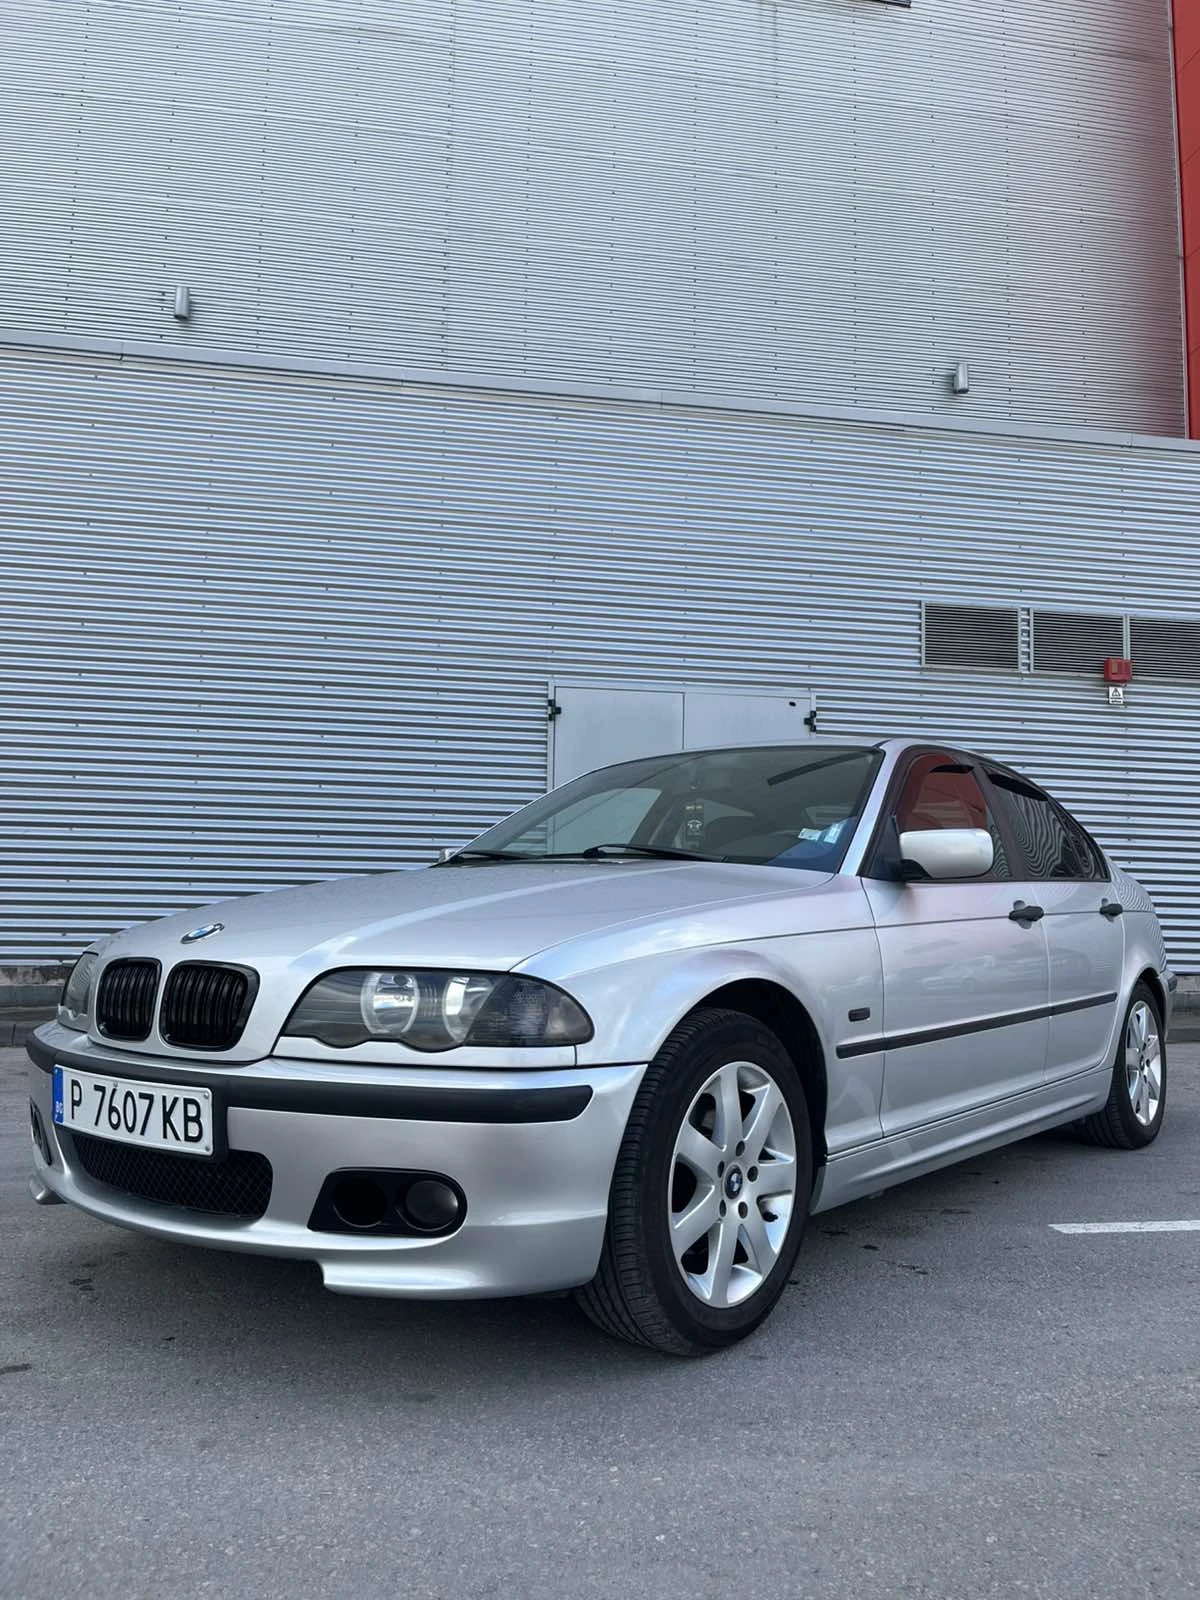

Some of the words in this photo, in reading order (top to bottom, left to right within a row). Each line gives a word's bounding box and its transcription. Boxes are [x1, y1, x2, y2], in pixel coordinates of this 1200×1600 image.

[71, 1079, 82, 1120] P
[93, 1084, 154, 1136] 7607
[162, 1095, 203, 1143] KB
